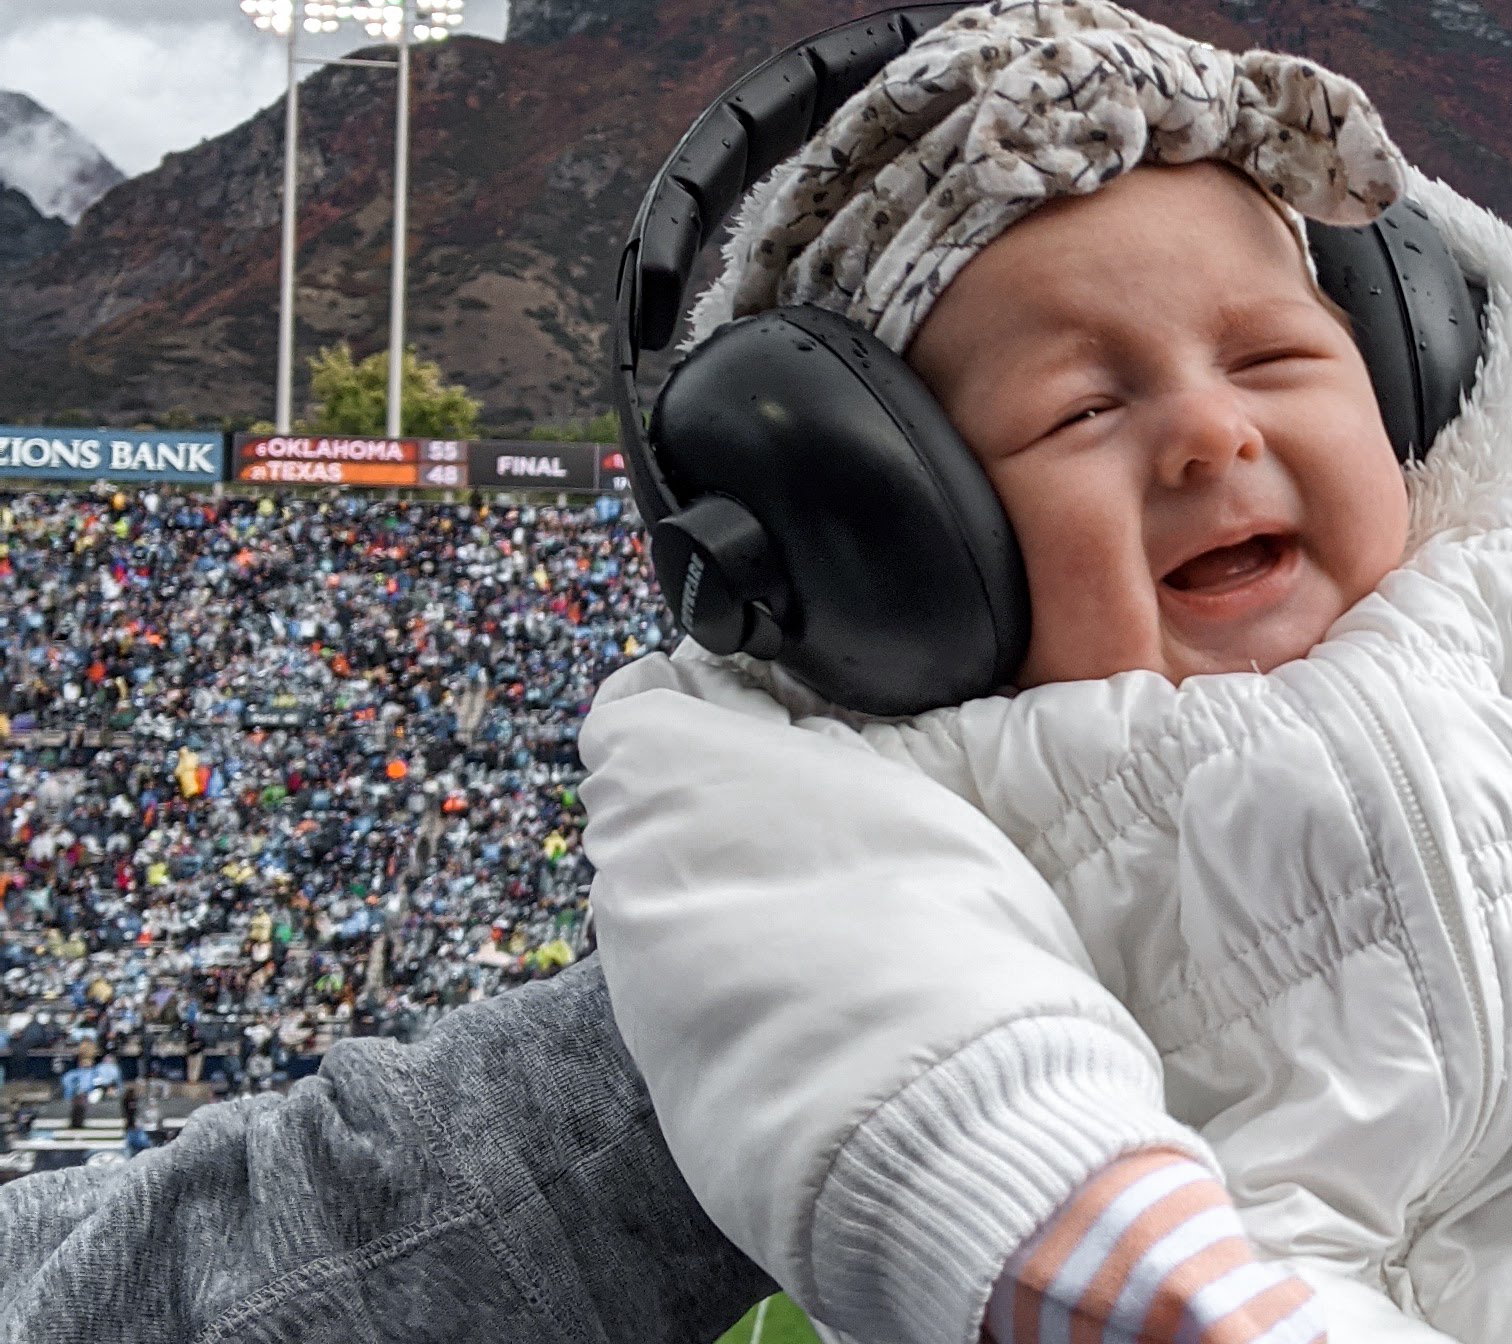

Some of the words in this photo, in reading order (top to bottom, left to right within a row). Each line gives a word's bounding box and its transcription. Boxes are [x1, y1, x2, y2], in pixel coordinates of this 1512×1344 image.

[109, 441, 215, 473] BANK
[267, 438, 404, 461] OKLAHOMA
[428, 440, 458, 461] 55
[266, 461, 342, 482] TEXAS
[427, 464, 458, 485] 48
[496, 456, 567, 478] FINAL
